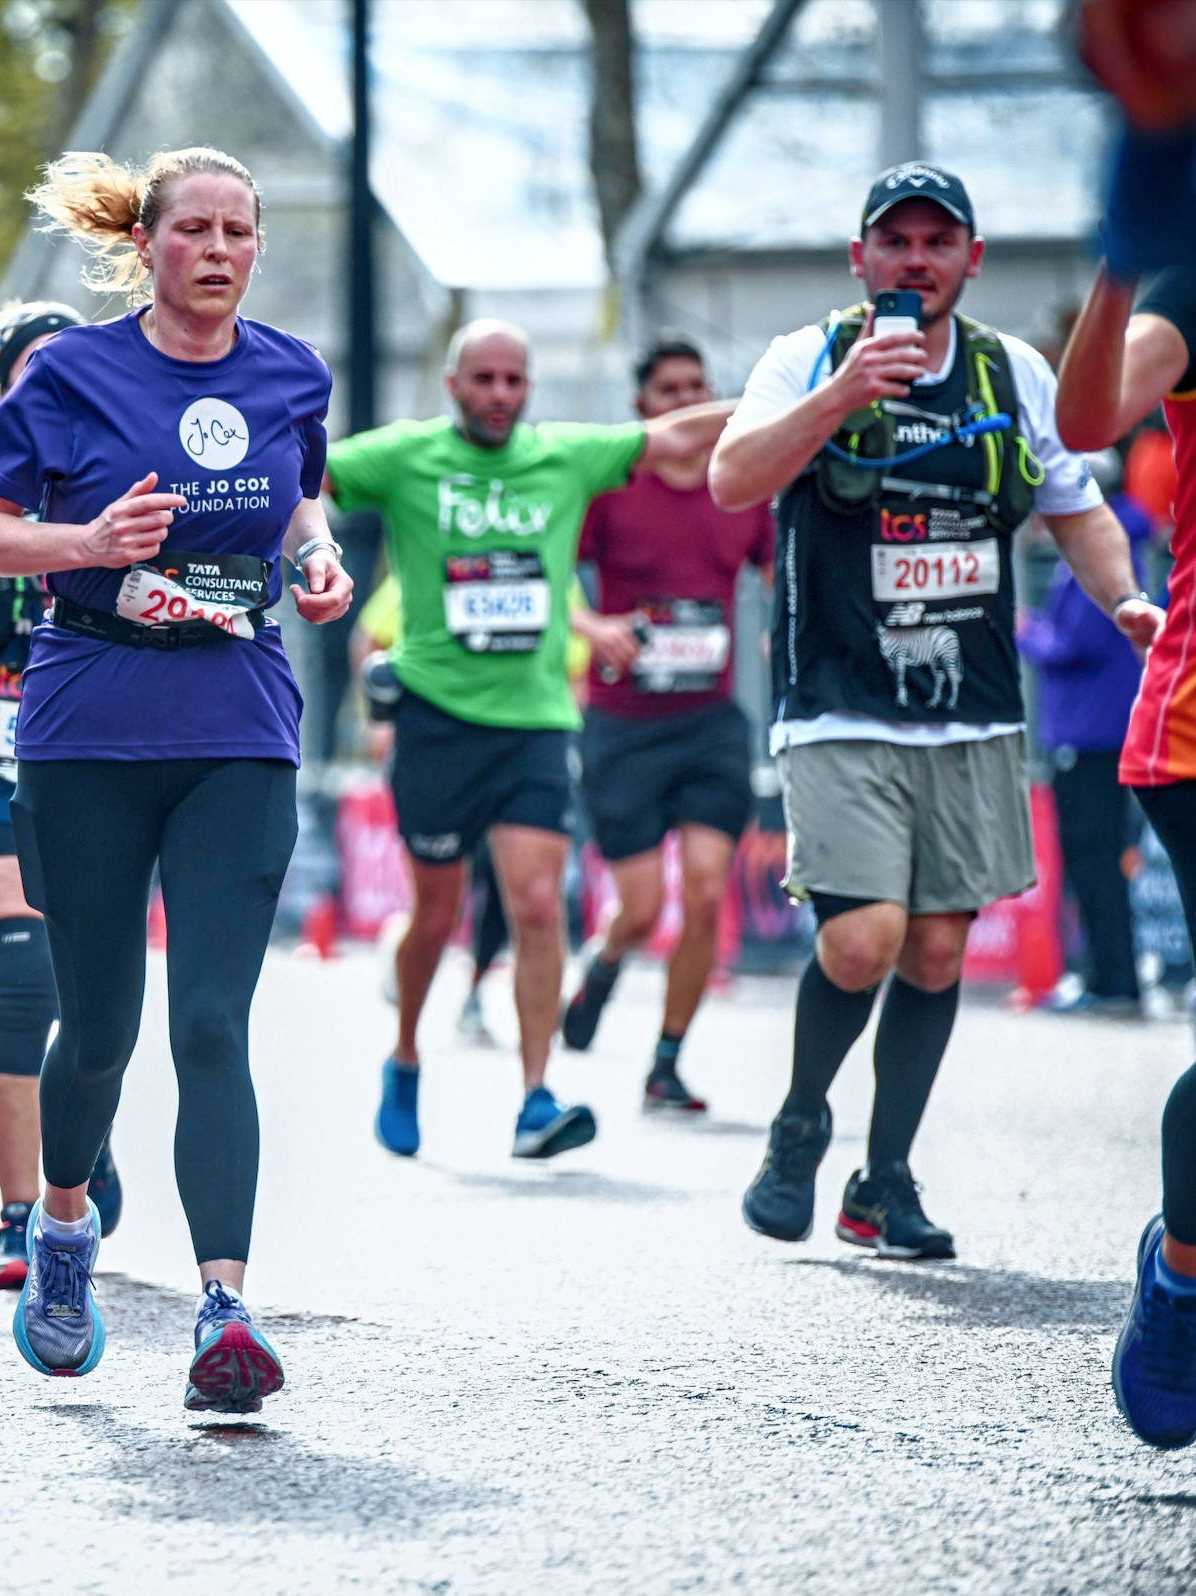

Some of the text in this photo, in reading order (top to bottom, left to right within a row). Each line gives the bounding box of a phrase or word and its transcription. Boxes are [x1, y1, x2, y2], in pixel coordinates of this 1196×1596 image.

[170, 477, 270, 496] THE JO COX
[880, 508, 928, 542] tcs
[187, 563, 221, 576] TATA
[894, 553, 980, 590] 20112
[185, 575, 263, 592] CONSULTANCY
